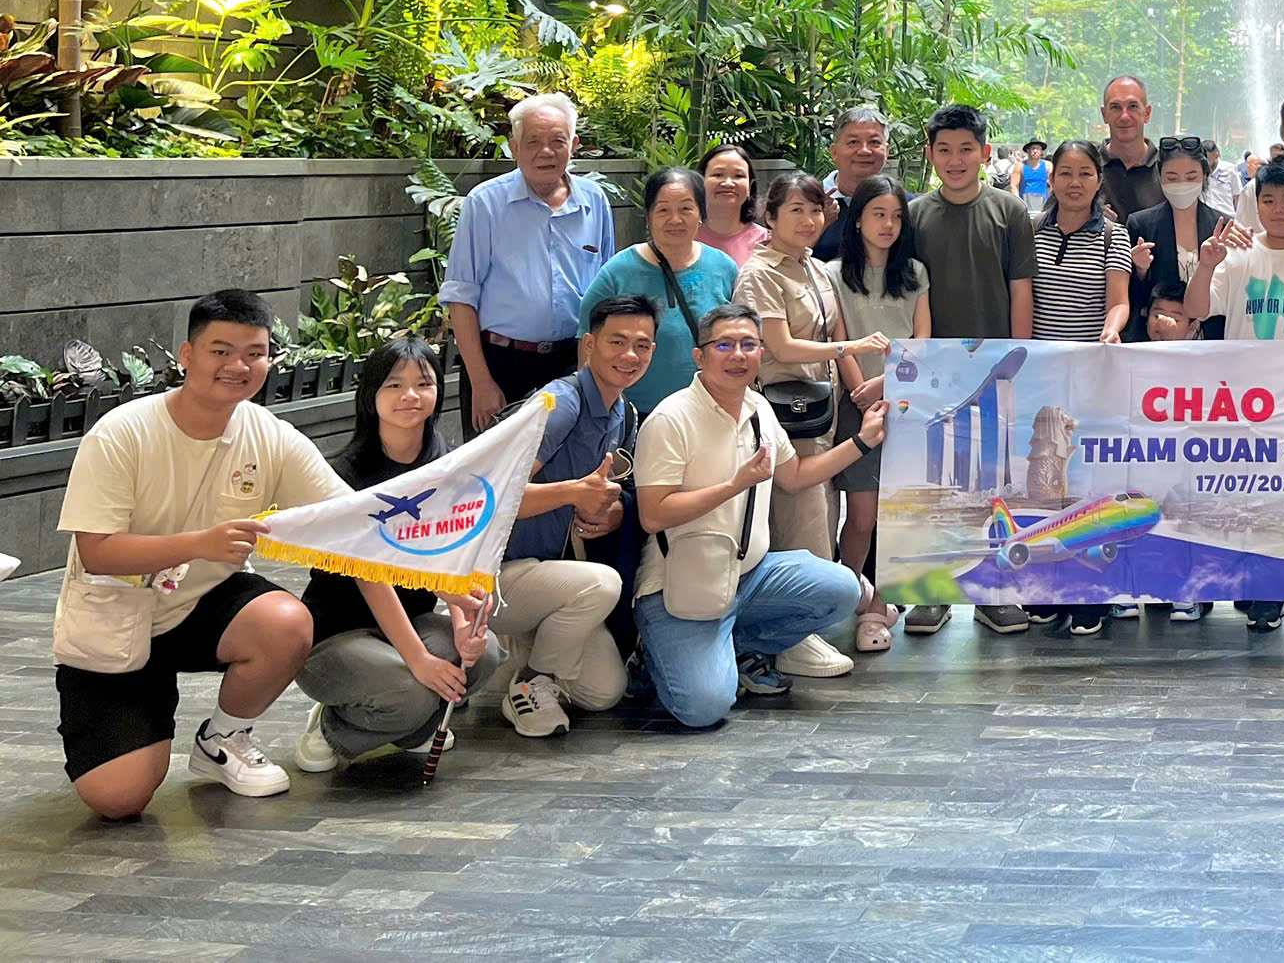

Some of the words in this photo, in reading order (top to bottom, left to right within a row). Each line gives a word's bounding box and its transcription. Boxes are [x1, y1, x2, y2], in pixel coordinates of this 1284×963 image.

[1245, 298, 1264, 315] NOW
[1266, 298, 1280, 314] OR
[1142, 381, 1276, 423] CHÀO
[1080, 437, 1177, 463] THAM
[1183, 437, 1278, 464] QUAN
[451, 500, 485, 515] TOUR
[397, 522, 431, 541] LIÊN
[435, 514, 476, 535] MINH
